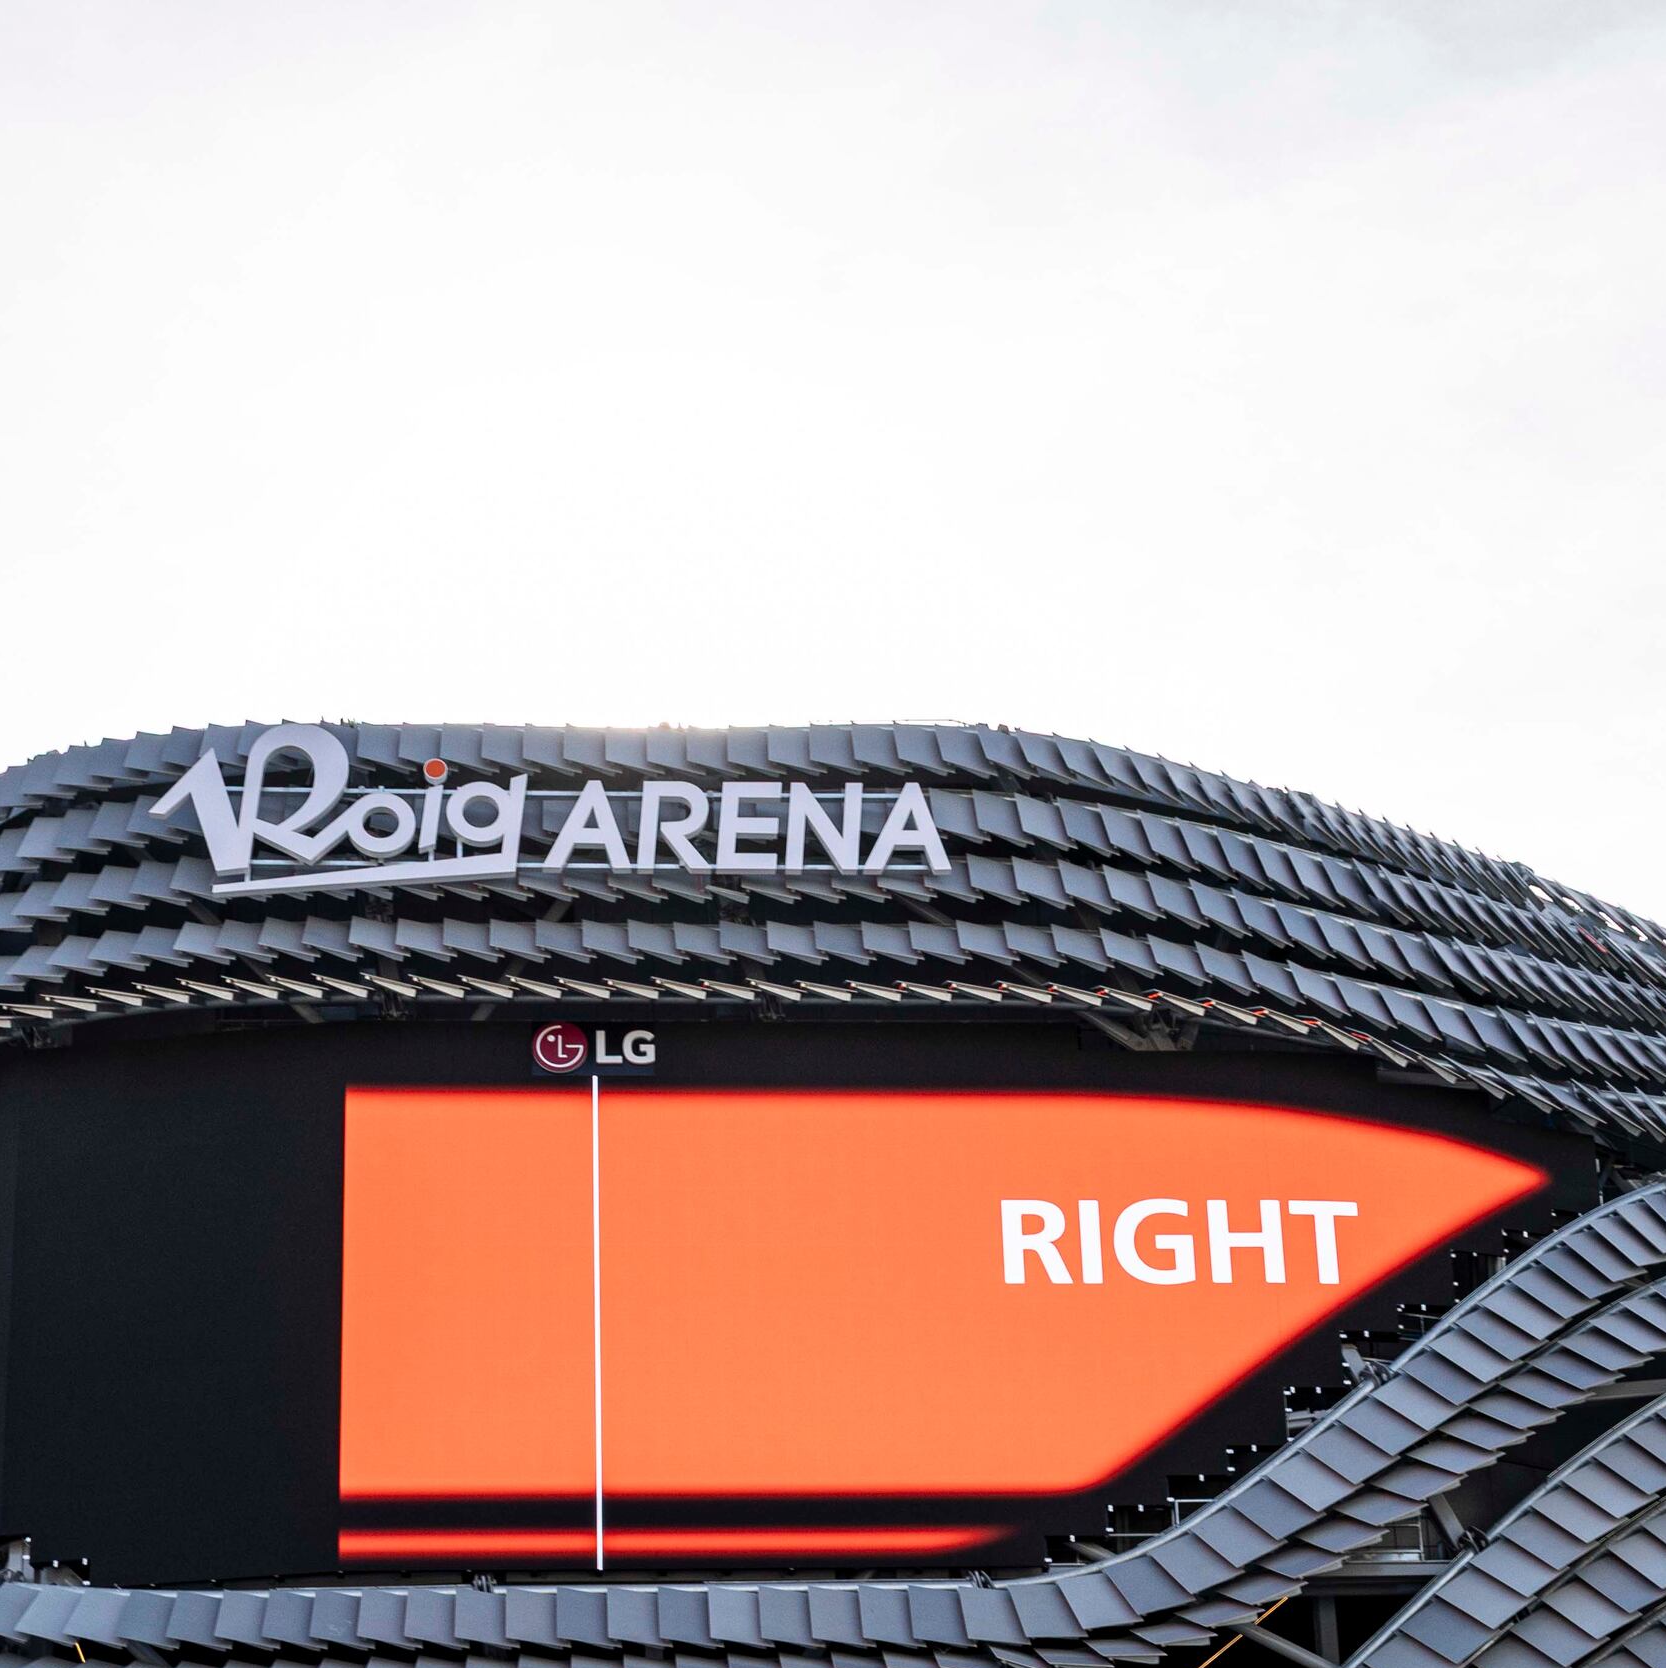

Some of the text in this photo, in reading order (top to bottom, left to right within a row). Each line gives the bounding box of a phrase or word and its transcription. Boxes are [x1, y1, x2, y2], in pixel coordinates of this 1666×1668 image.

[149, 724, 952, 893] Roig ARENA
[595, 1029, 656, 1065] LG
[1001, 1198, 1358, 1285] RIGHT
